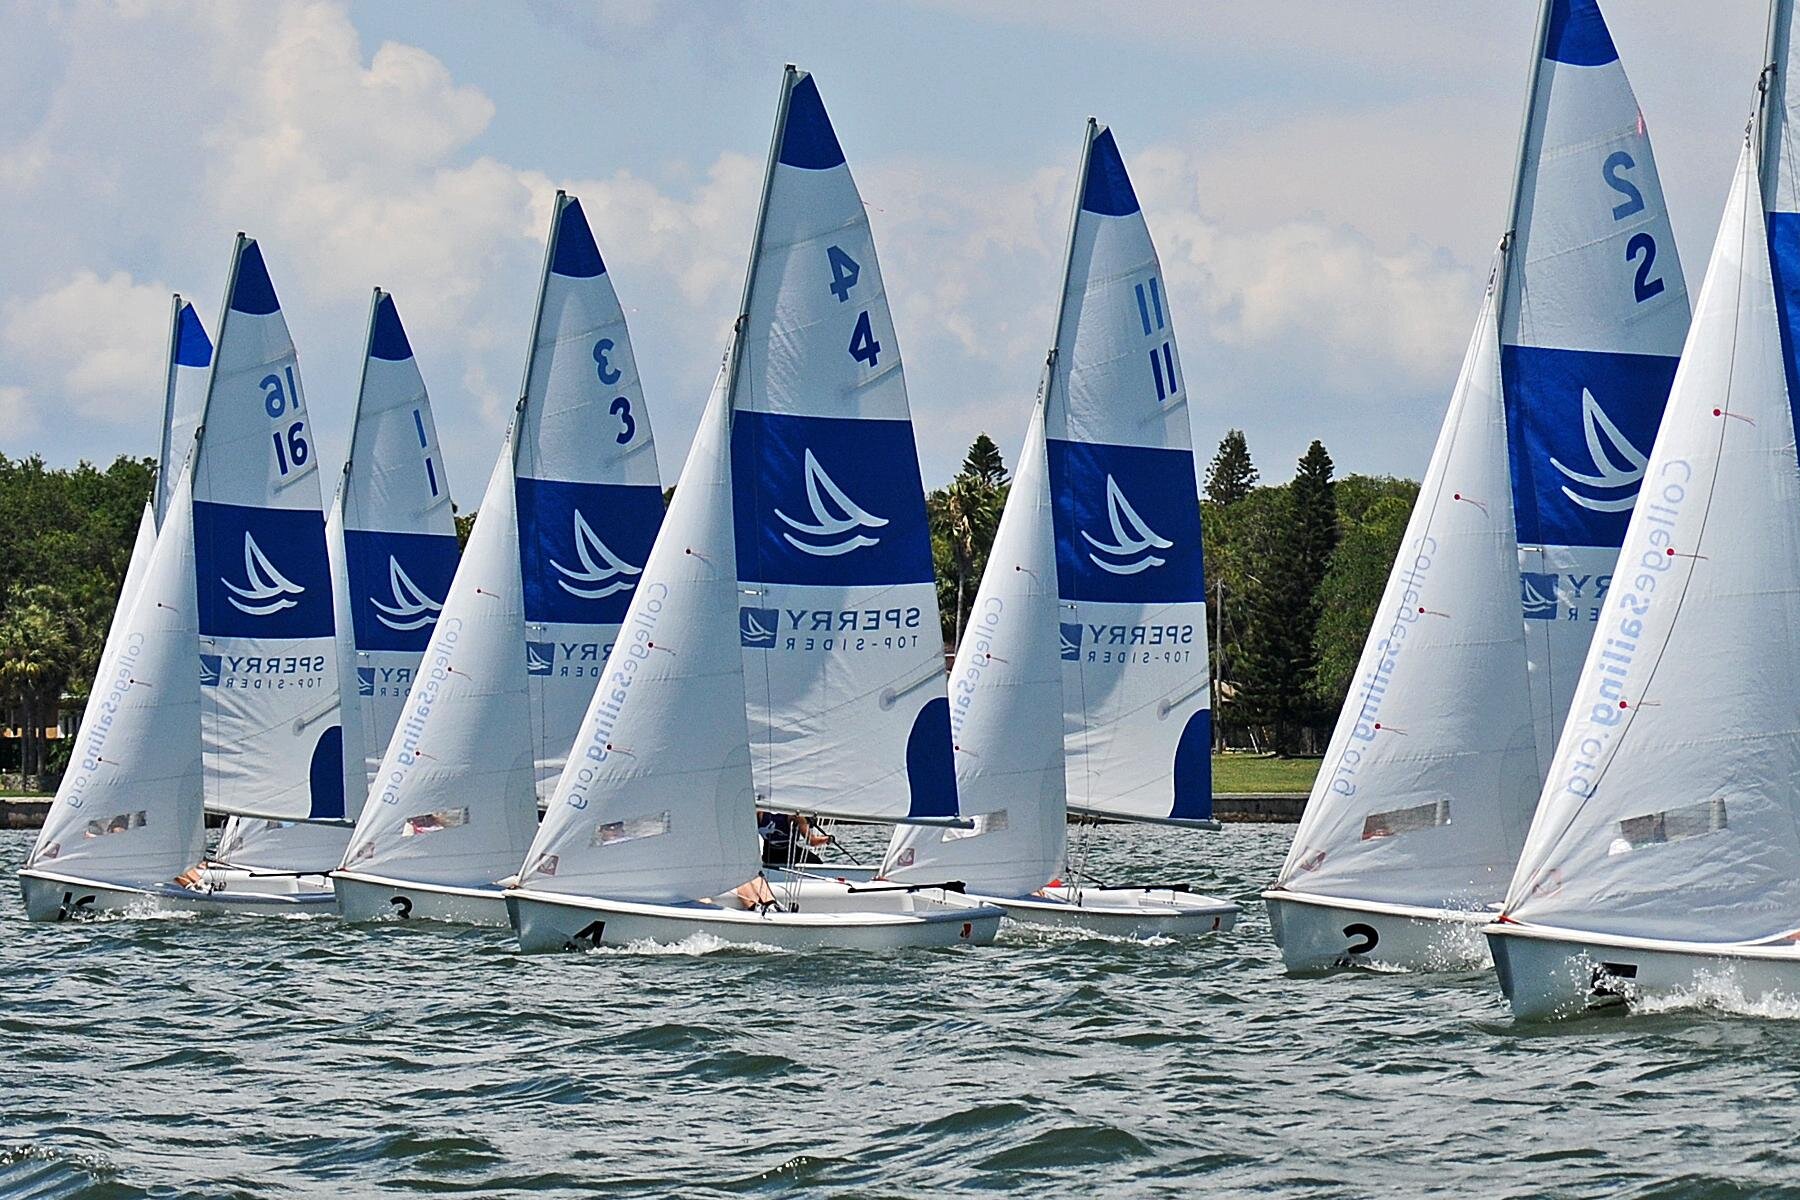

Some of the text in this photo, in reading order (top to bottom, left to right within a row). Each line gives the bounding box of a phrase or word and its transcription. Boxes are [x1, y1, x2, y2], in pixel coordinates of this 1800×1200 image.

[1626, 232, 1665, 303] 2
[848, 310, 881, 368] 4
[1149, 341, 1178, 402] 11
[272, 421, 309, 476] 16
[609, 396, 636, 445] 3
[425, 457, 439, 497] 1
